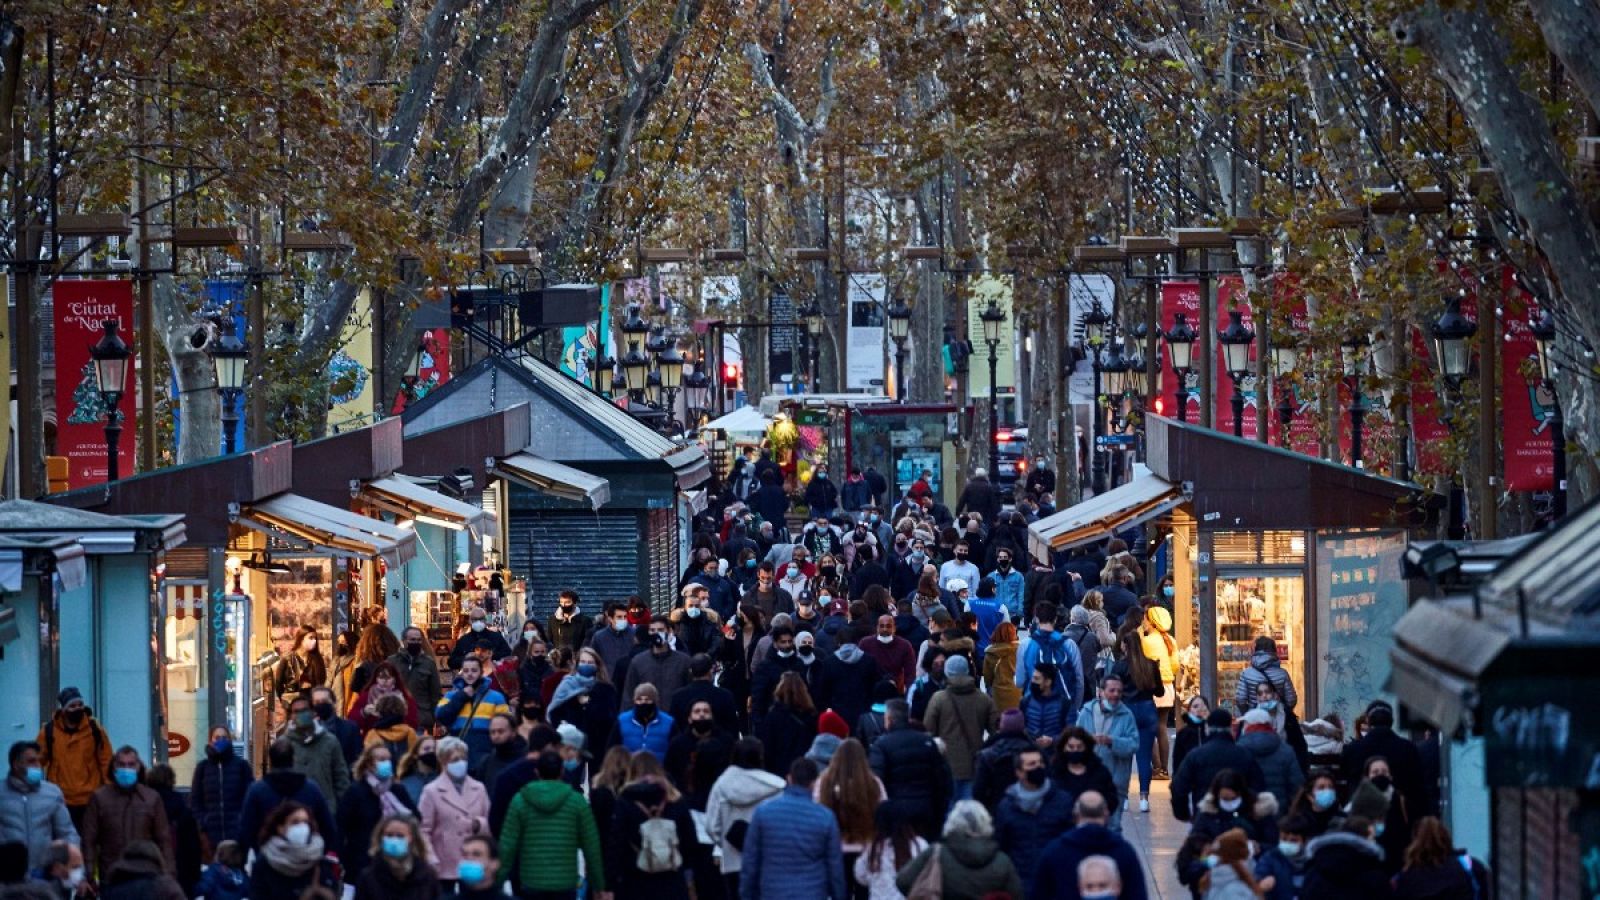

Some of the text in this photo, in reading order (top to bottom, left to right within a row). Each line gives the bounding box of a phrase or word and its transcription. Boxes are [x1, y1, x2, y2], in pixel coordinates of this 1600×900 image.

[67, 302, 117, 316] Ciutat
[63, 315, 126, 332] de Nadl
